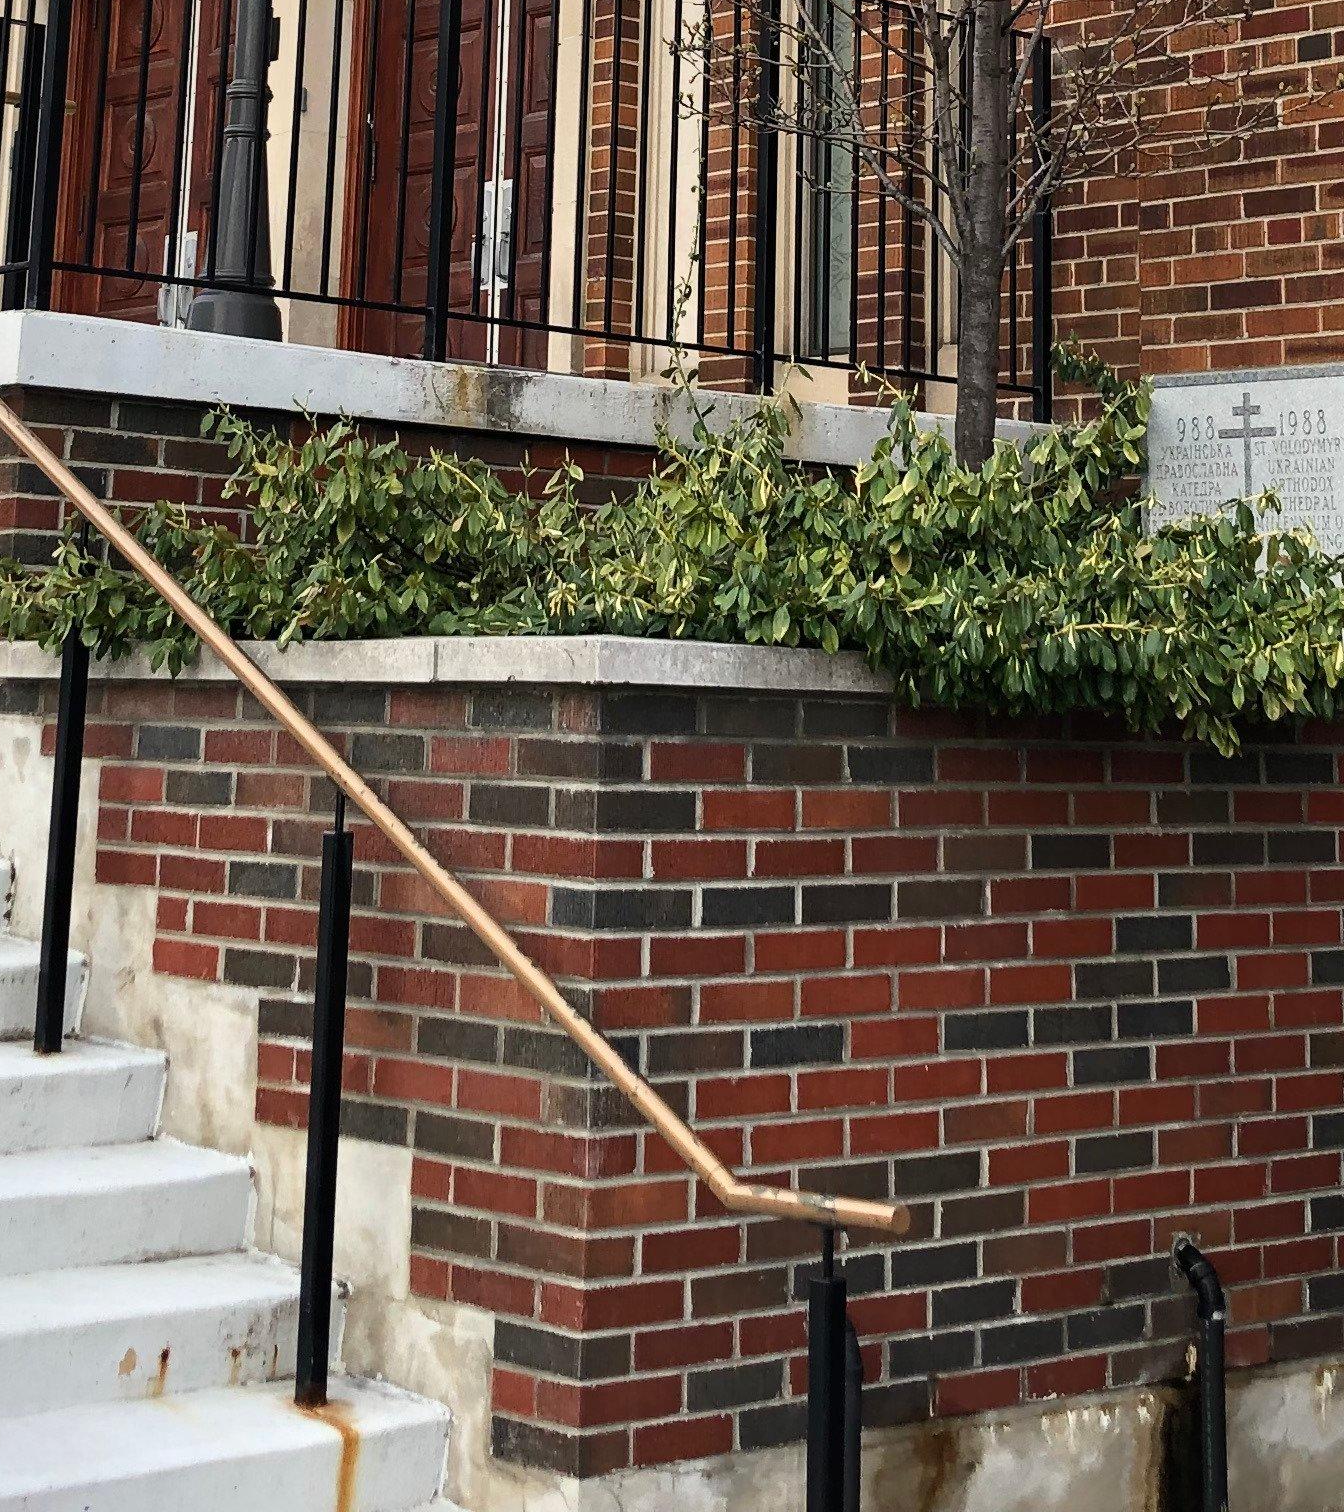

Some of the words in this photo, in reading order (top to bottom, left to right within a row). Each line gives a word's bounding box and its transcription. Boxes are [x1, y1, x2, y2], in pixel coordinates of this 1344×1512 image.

[1177, 416, 1215, 443] 988
[1280, 409, 1326, 436] 1988
[1268, 457, 1336, 475] UKRAINIAN
[1172, 481, 1222, 497] КАТЕДРА
[1270, 476, 1334, 493] ORTHODOX
[1273, 494, 1337, 512] THEDRAL
